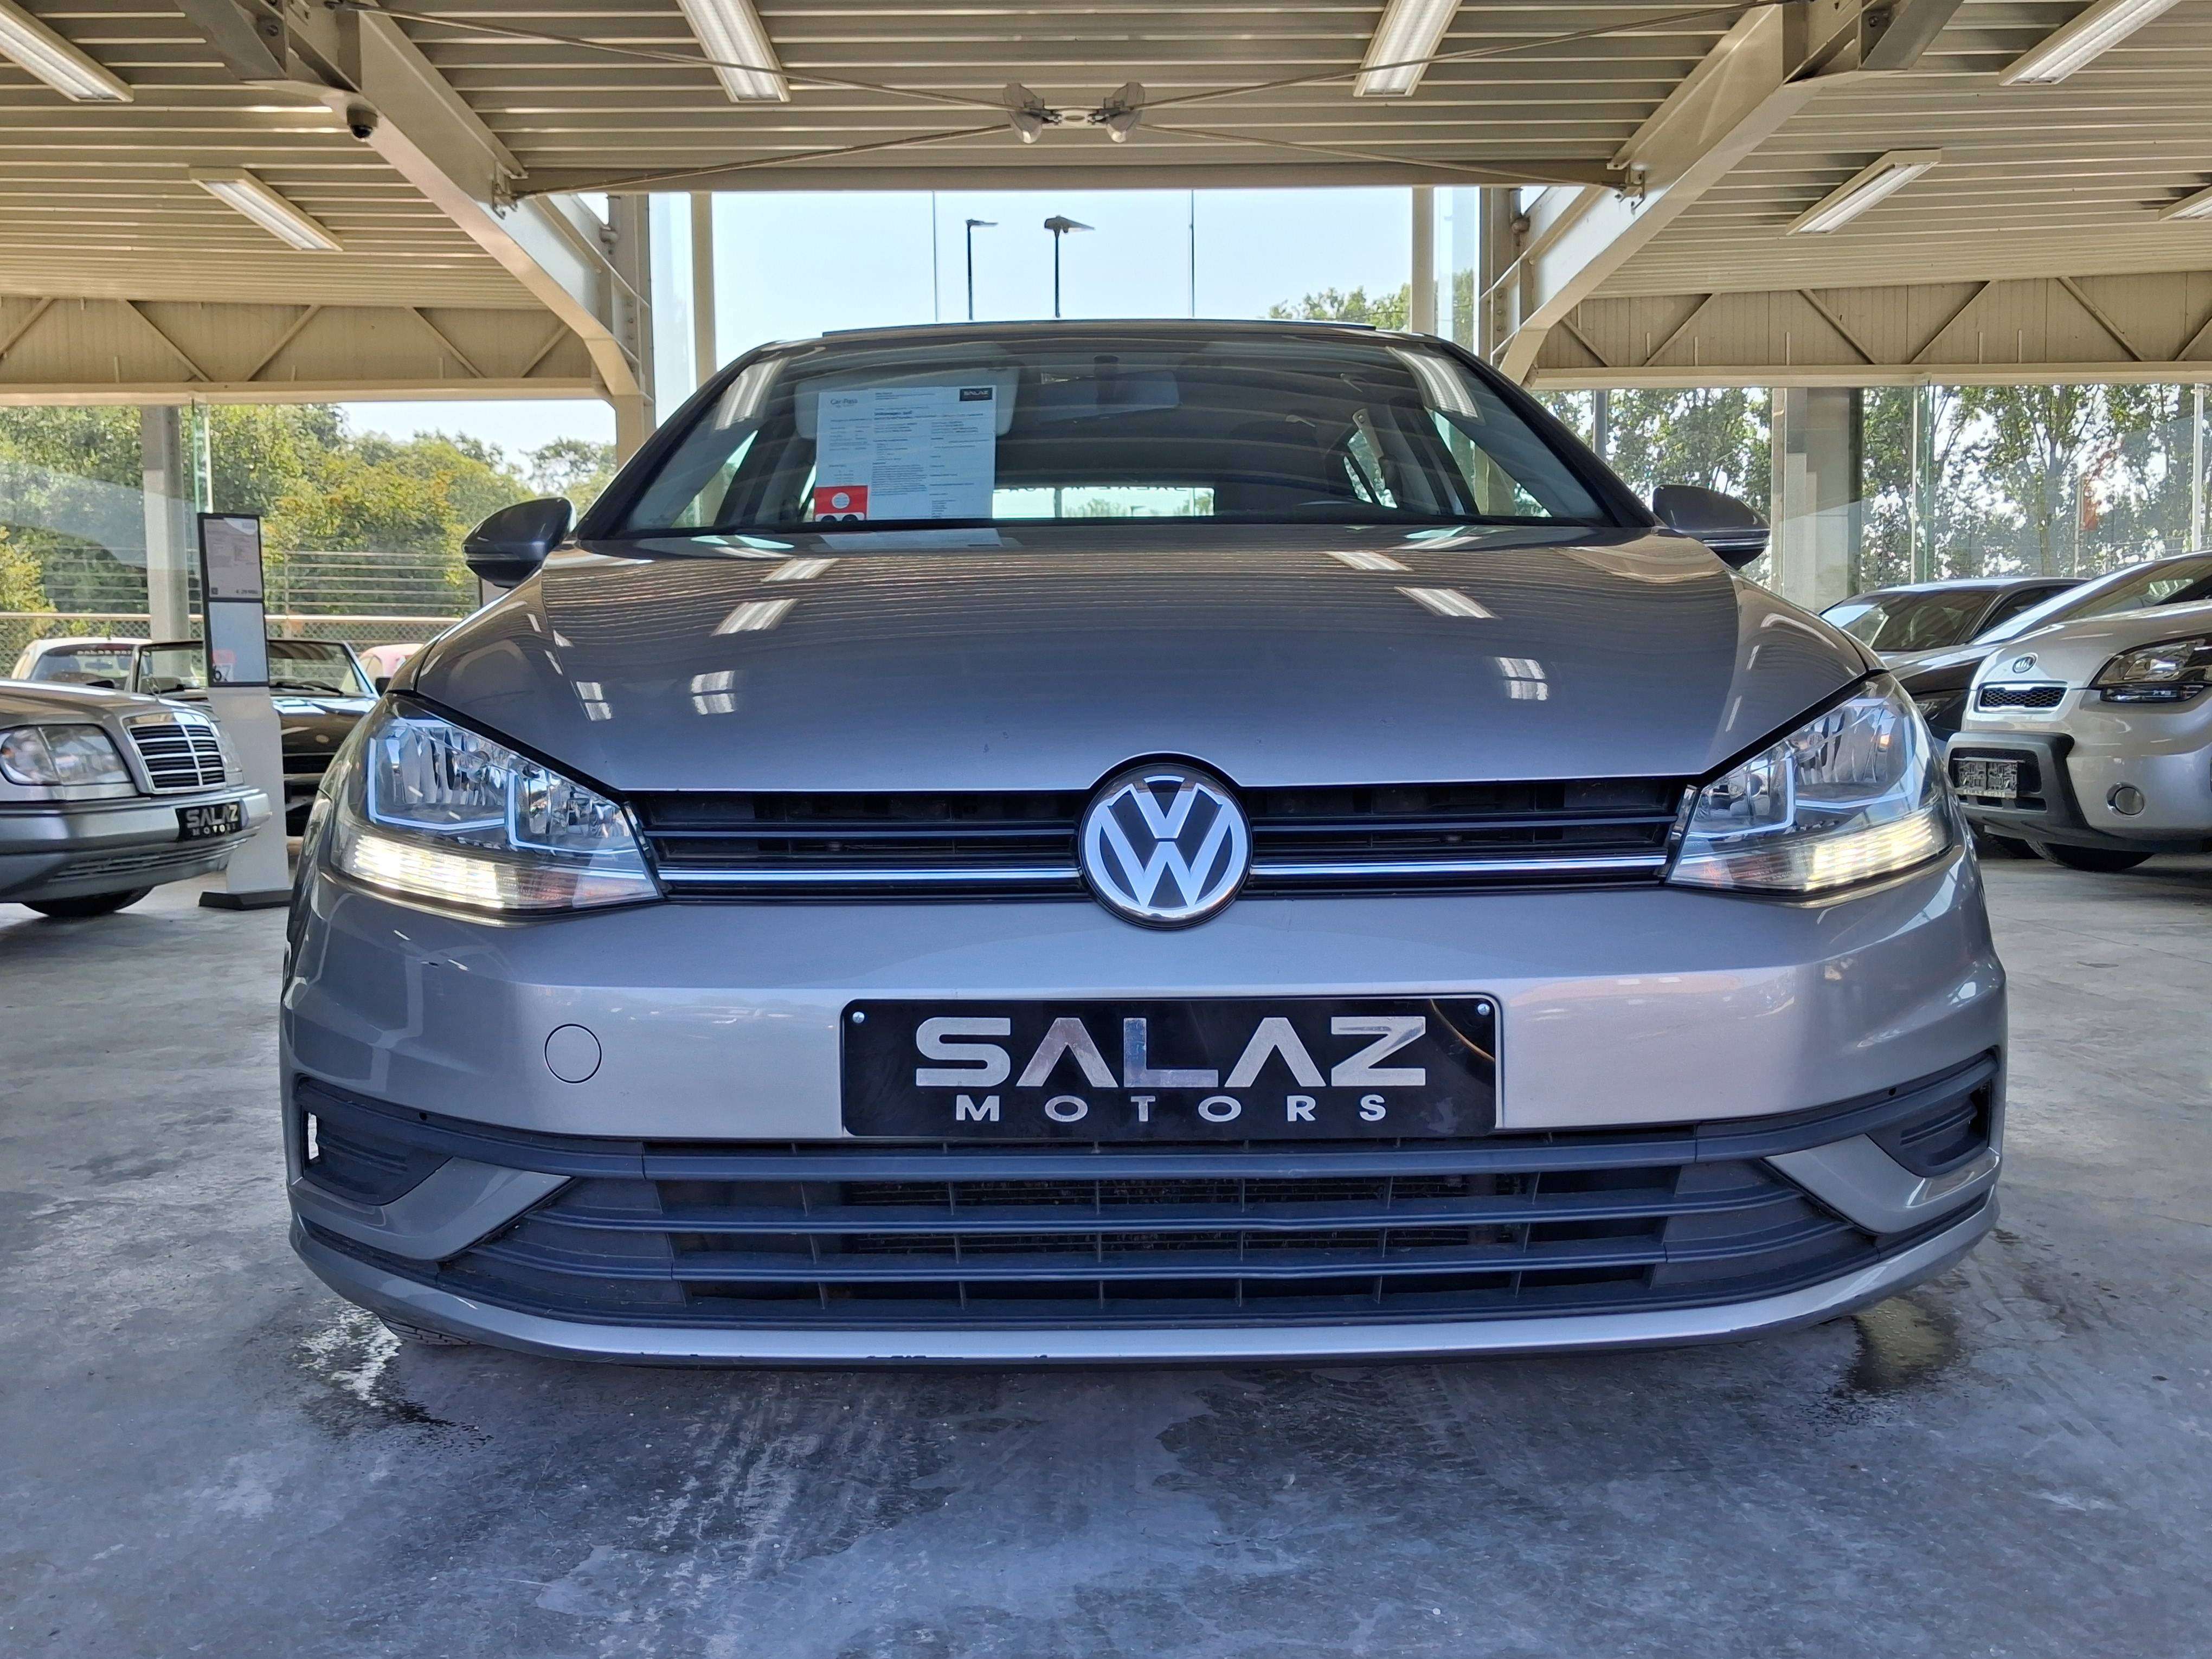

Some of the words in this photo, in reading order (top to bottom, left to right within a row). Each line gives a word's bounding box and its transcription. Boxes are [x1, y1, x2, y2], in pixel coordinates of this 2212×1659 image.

[186, 804, 239, 829] SALAZ
[915, 1017, 1427, 1088] SALAZ
[955, 1095, 1386, 1123] MOTORS
